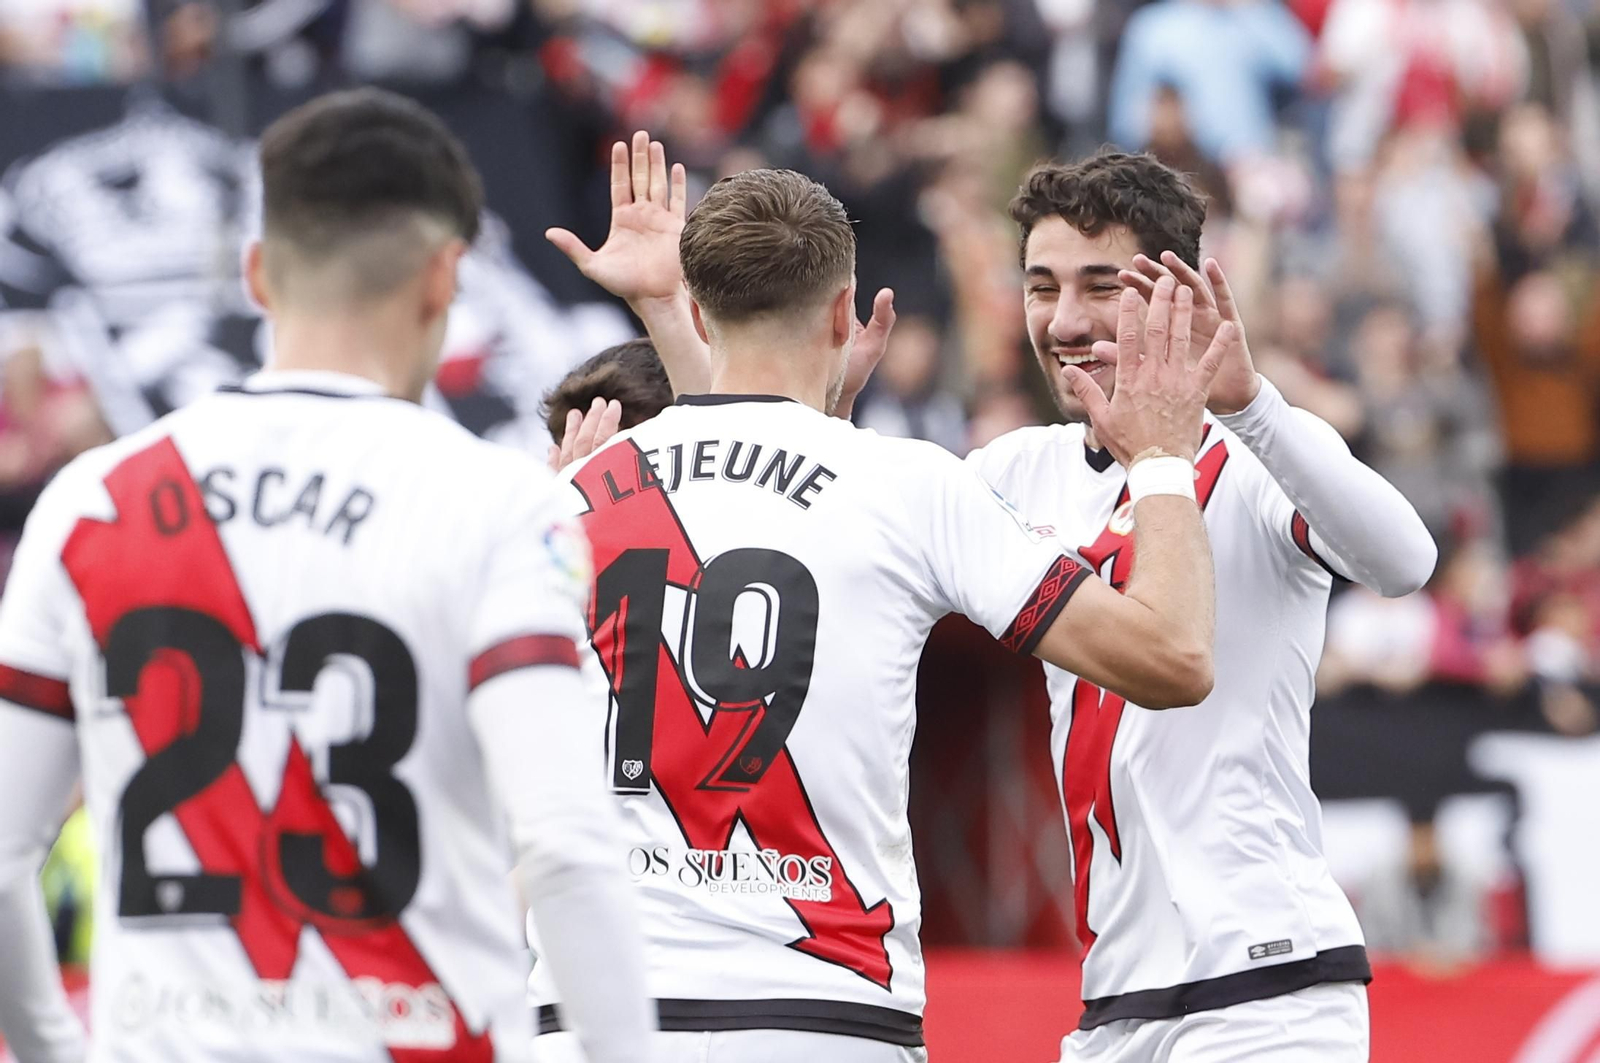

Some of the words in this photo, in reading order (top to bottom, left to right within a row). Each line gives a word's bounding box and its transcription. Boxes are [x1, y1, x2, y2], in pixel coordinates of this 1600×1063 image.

[150, 465, 375, 546] OSCAR
[601, 440, 838, 510] LEJEUNE
[589, 547, 820, 794] 19
[102, 606, 421, 926] 23
[629, 846, 669, 882] OS
[678, 848, 833, 888] SUEÑOS
[708, 881, 830, 900] DEVELOPMENTS
